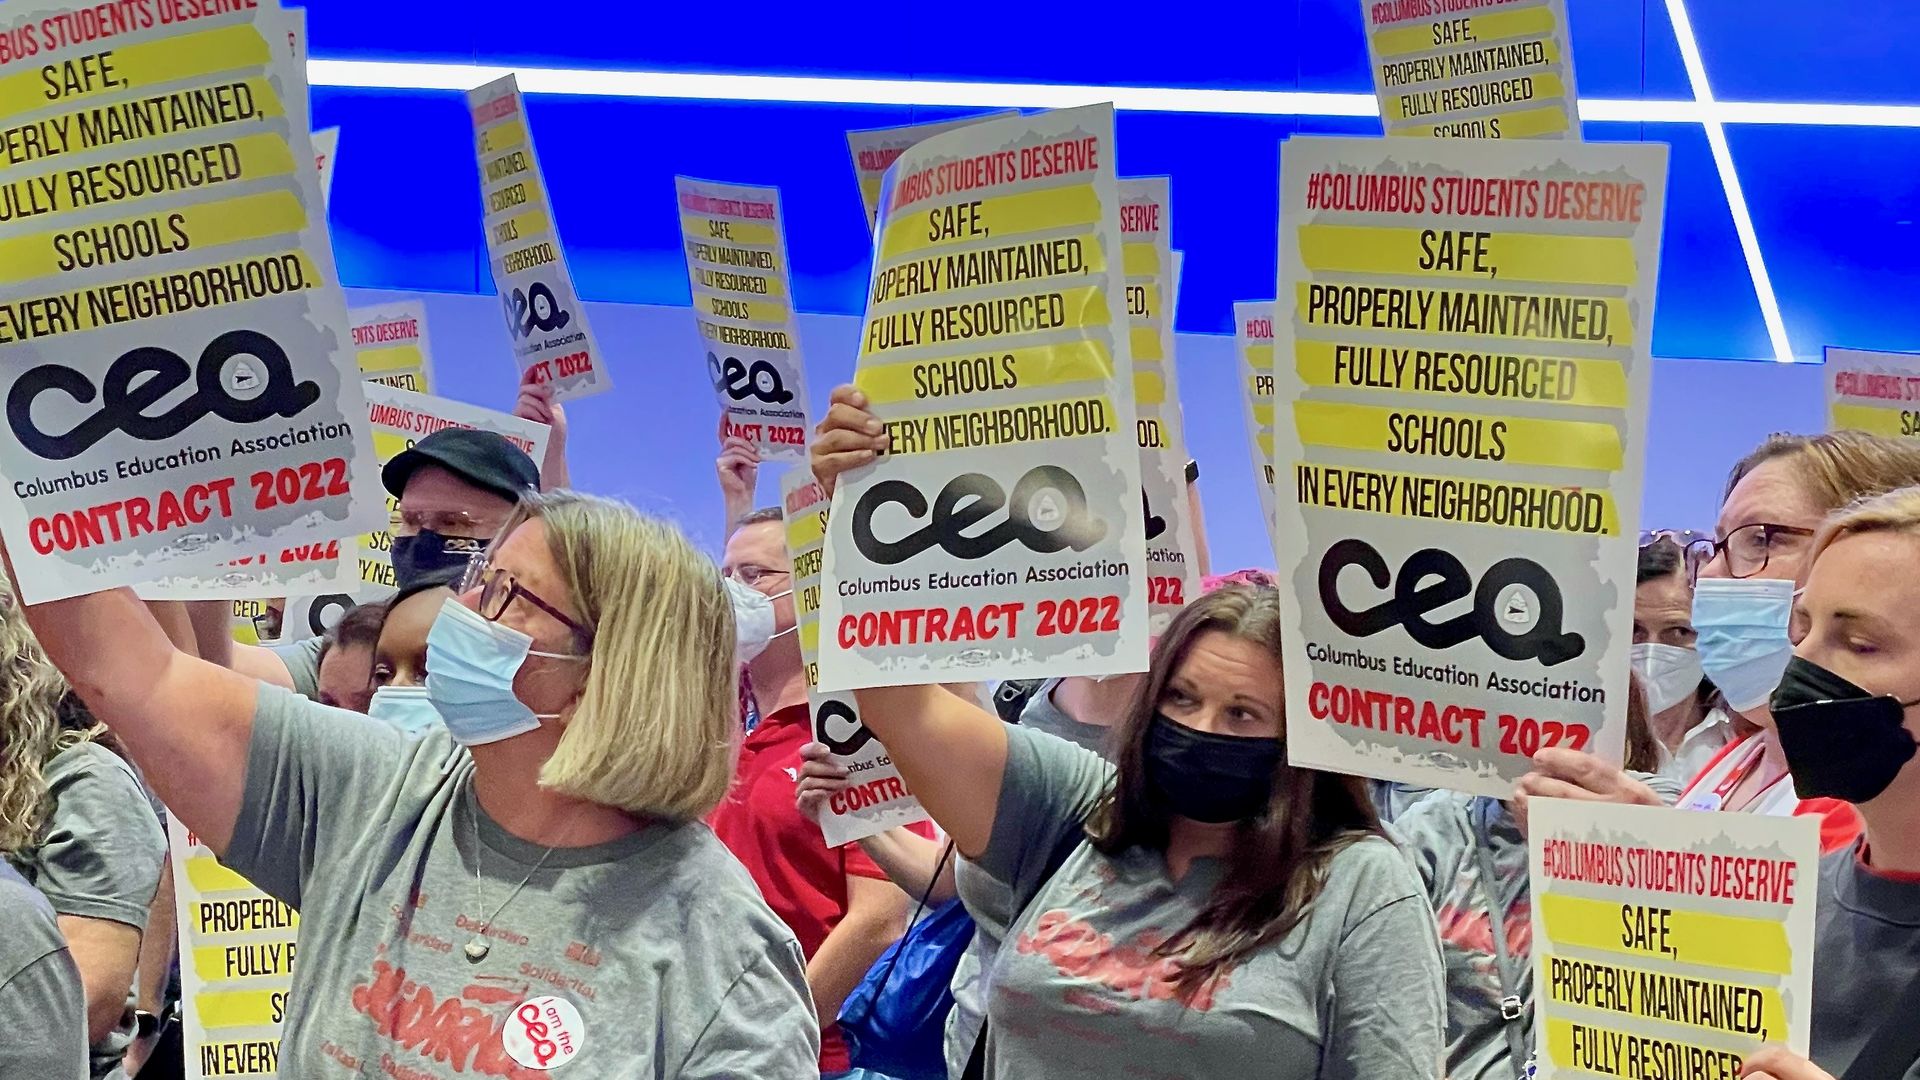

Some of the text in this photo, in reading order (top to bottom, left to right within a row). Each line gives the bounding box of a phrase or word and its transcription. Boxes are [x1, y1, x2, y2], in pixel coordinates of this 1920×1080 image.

[42, 0, 154, 51] STUDENTS
[1432, 18, 1477, 46] SAFE,
[41, 51, 129, 100] SAFE,
[1382, 40, 1549, 87] PROPERLY MAINTAINED,
[76, 82, 264, 148] MAINTAINED,
[1401, 77, 1533, 118] FULLY RESOURCED
[68, 142, 242, 208] RESOURCED
[936, 151, 1016, 196] STUDENTS
[1020, 136, 1098, 180] DESERVE
[928, 200, 989, 242] SAFE,
[1120, 203, 1160, 233] SERVE
[1307, 173, 1646, 223] #COLUMBUS STUDENTS DESERVE
[53, 213, 190, 272] SCHOOLS
[709, 219, 735, 242] SAFE,
[1418, 229, 1498, 279] SAFE,
[715, 271, 767, 299] RESOURCED
[946, 238, 1089, 290] MAINTAINED,
[86, 254, 313, 327] NEIGHBORHOOD.
[711, 297, 749, 320] SCHOOLS
[376, 318, 419, 342] DESERVE
[719, 323, 791, 350] NEIGHBORHOOD.
[868, 292, 1065, 353] FULLY RESOURCED
[1308, 284, 1614, 348] PROPERLY MAINTAINED,
[555, 351, 593, 378] 2022
[913, 354, 1018, 399] SCHOOLS
[1334, 345, 1577, 401] FULLY RESOURCED
[768, 425, 806, 445] 2022
[934, 399, 1111, 451] NEIGHBORHOOD.
[1387, 412, 1508, 461] SCHOOLS
[14, 421, 352, 499] Columbus Education Association
[28, 477, 236, 555] CONTRACT
[250, 457, 350, 510] 2022
[1296, 465, 1609, 536] IN EVERY NEIGHBORHOOD.
[838, 559, 1130, 599] Columbus Education Association
[1146, 547, 1185, 563] iation
[837, 595, 1121, 650] CONTRACT 2022
[1306, 641, 1606, 705] Columbus Education Association
[1308, 682, 1486, 749] CONTRACT
[1543, 838, 1797, 905] #COLUMBUS STUDENTS DESERVE
[200, 899, 293, 934] PROPERLY
[1621, 904, 1678, 961] SAFE,
[225, 943, 281, 978] FULLY
[1551, 957, 1768, 1042] PROPERLY MAINTAINED,
[541, 998, 574, 1055] I am the
[1572, 1024, 1623, 1076] FULLY
[201, 1044, 220, 1076] IN
[224, 1040, 281, 1074] EVERY
